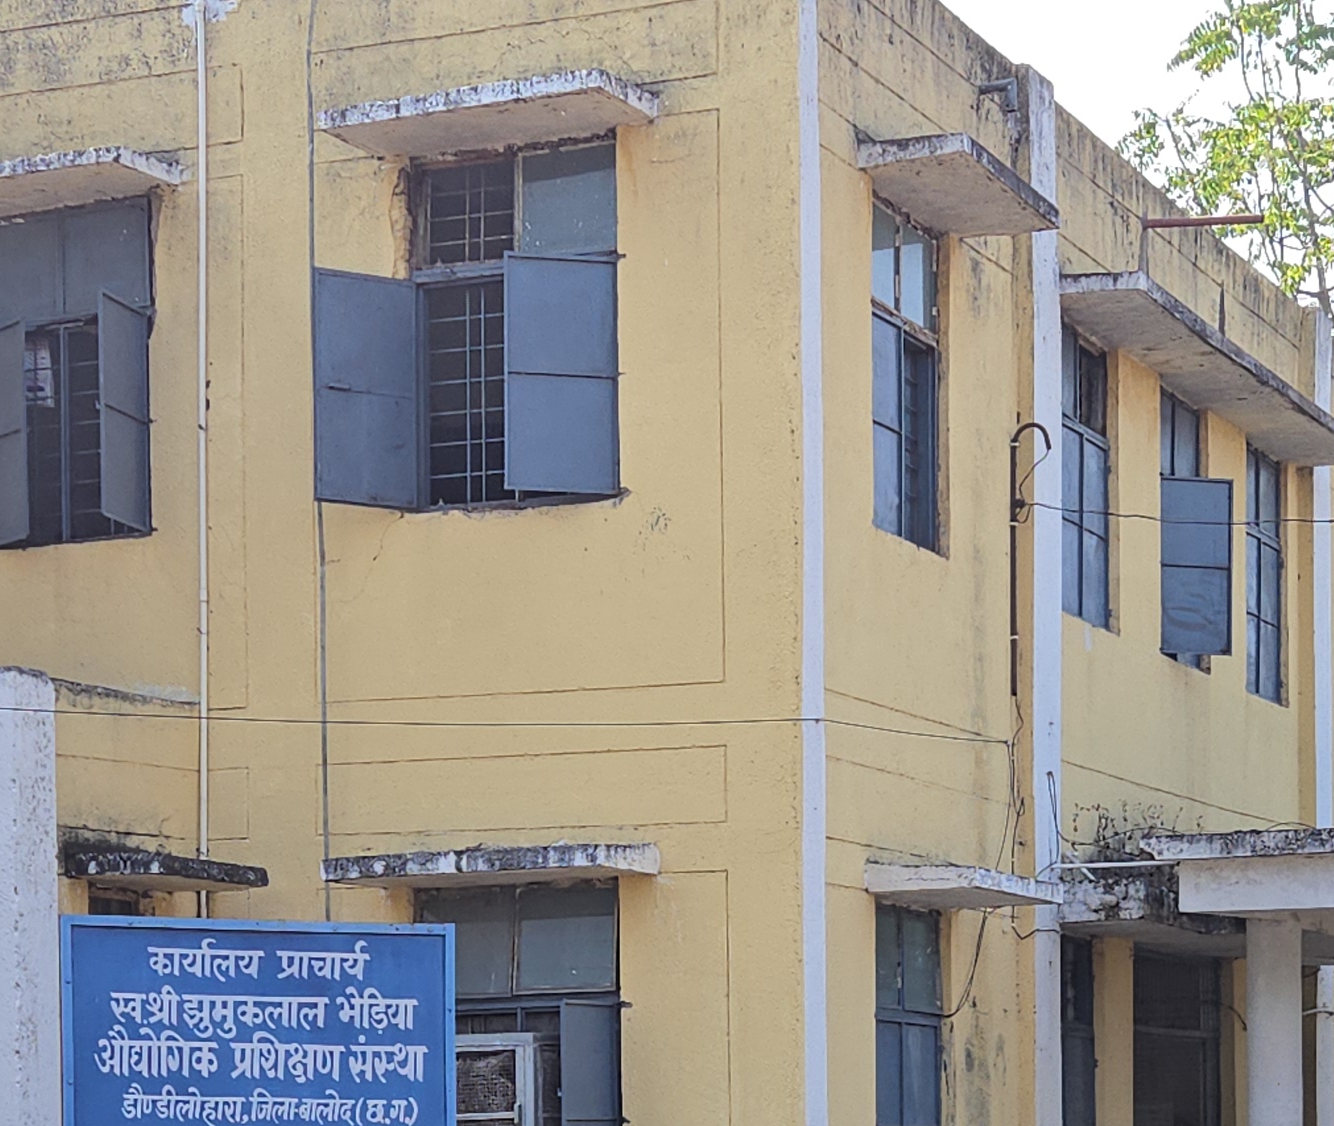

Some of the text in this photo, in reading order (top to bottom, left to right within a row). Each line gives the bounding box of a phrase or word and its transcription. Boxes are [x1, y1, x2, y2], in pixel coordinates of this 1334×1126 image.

[147, 938, 370, 983] कार्यालय प्राचार्य
[336, 986, 419, 1035] भेड़िया
[93, 1024, 429, 1083] औद्योगिक प्रशिक्षण संस्था
